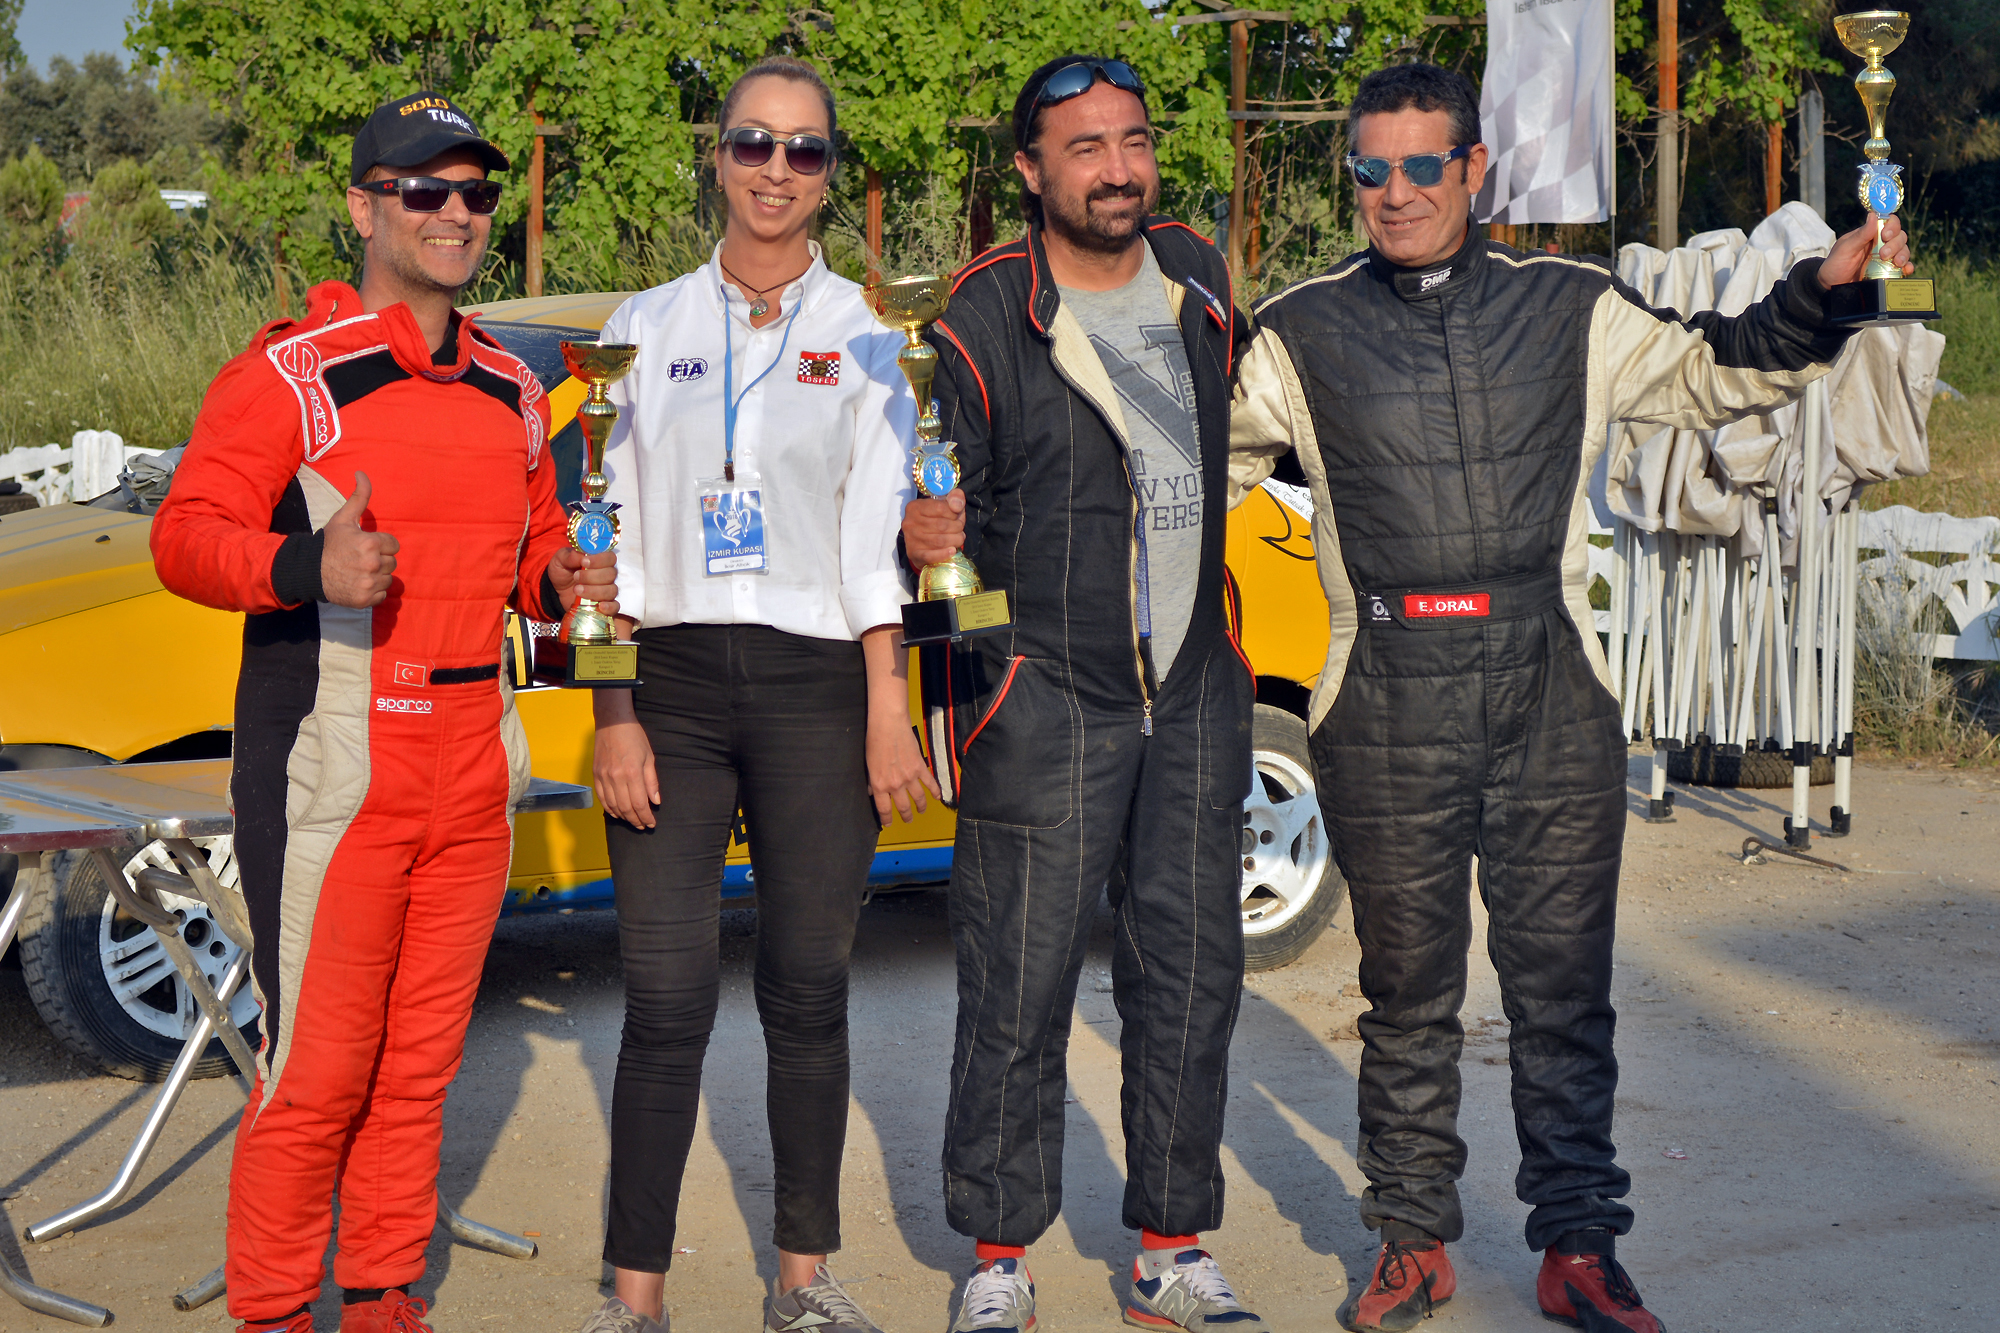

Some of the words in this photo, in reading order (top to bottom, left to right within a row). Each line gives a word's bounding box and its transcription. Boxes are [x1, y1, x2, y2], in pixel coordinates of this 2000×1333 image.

[399, 97, 449, 116] SOLO
[1421, 270, 1451, 288] OMP
[800, 375, 836, 386] TOSFED
[306, 387, 328, 444] sparco
[1144, 500, 1204, 531] ERS
[1436, 600, 1478, 613] ORAL
[376, 697, 432, 713] sparco
